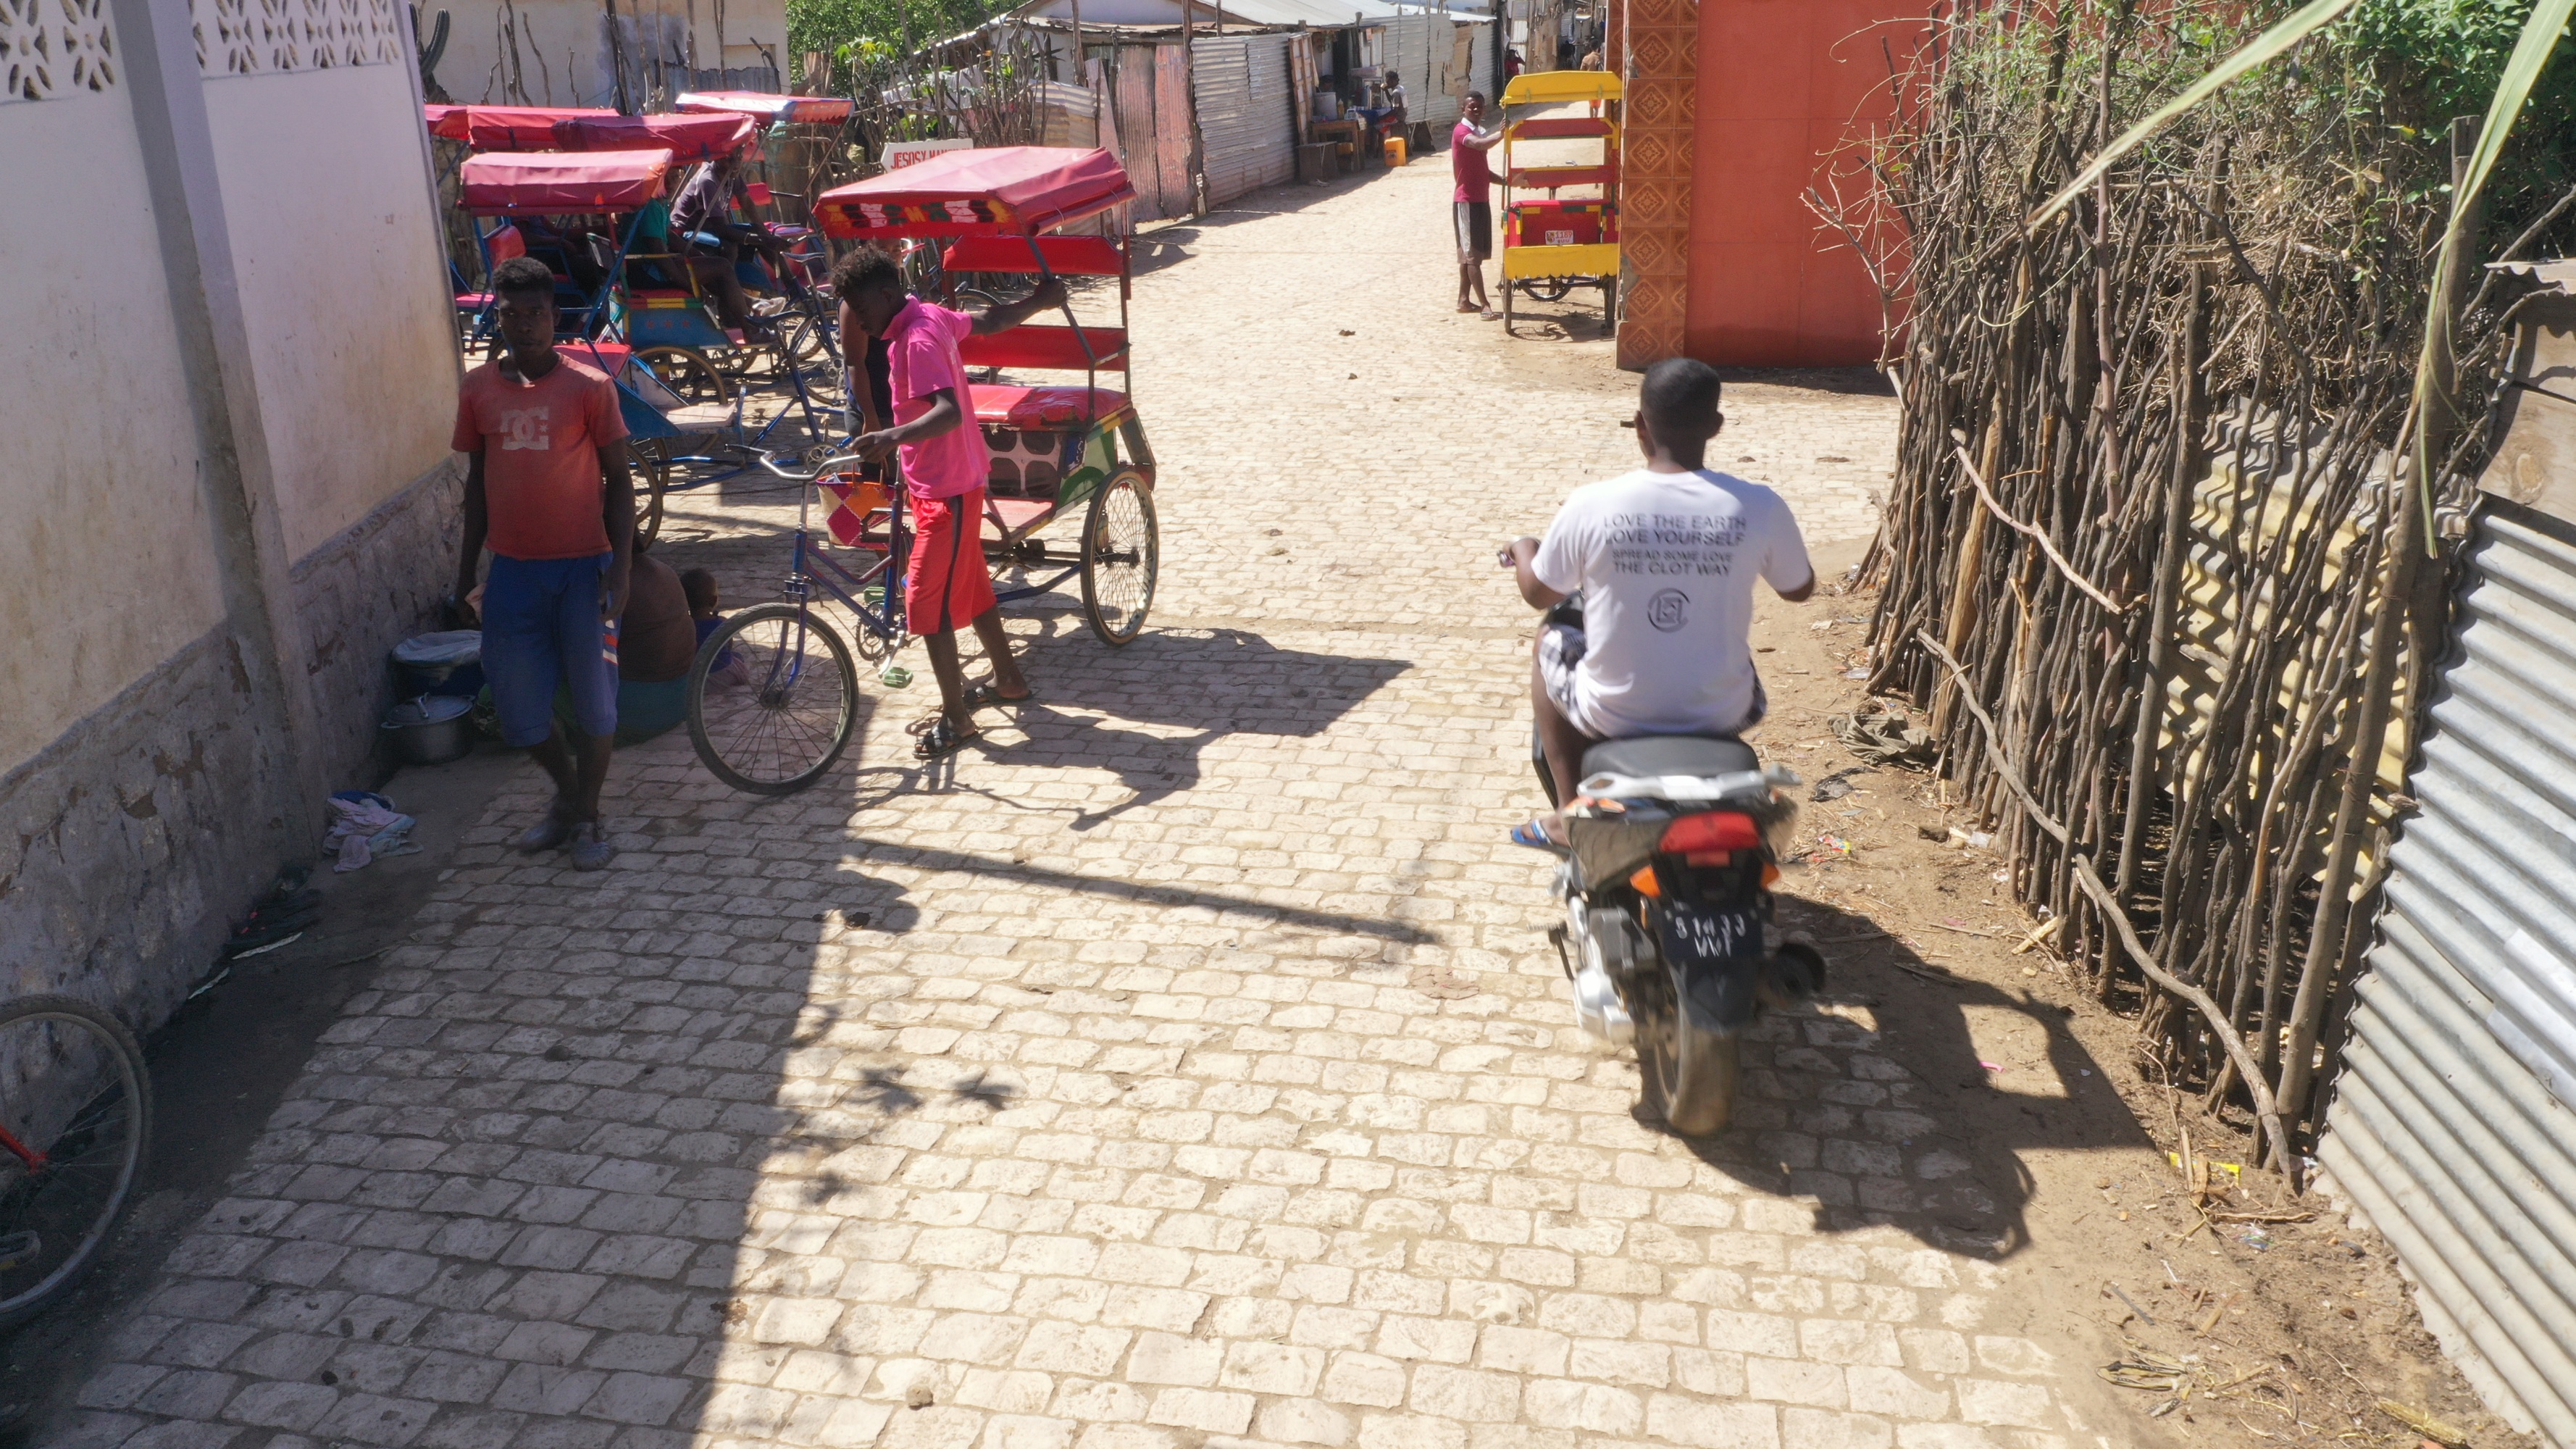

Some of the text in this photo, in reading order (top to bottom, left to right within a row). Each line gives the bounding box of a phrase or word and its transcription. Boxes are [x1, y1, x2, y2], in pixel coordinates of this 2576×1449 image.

[890, 150, 927, 170] JESOSY
[500, 406, 550, 451] DC
[1604, 513, 1747, 531] LOVE THE EARTH
[1605, 528, 1745, 546] LOVE YOURSELF
[1613, 549, 1733, 562] SPREAD SOME LOVE
[1613, 561, 1730, 577] THE CLOT WAY
